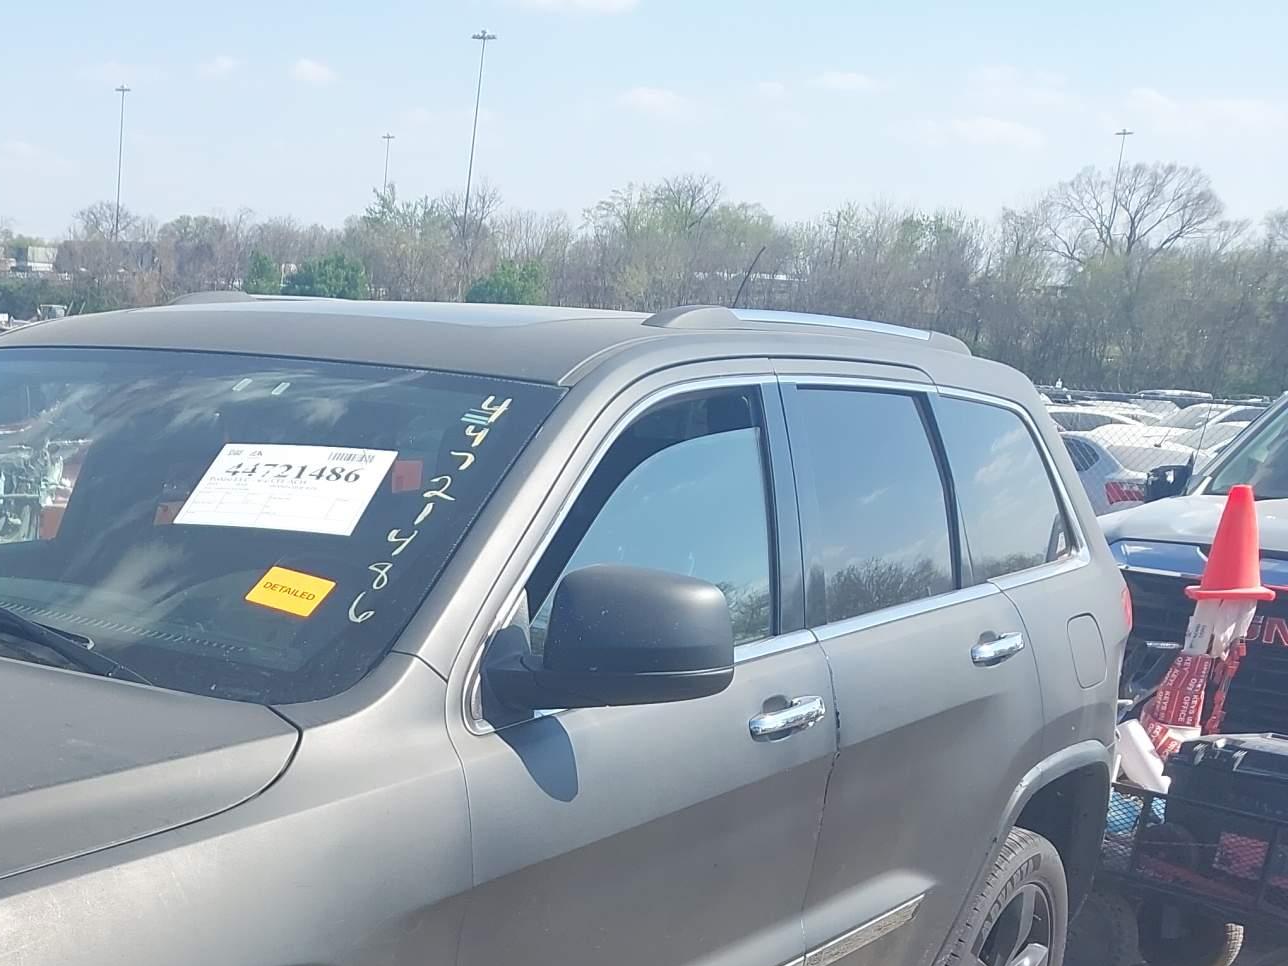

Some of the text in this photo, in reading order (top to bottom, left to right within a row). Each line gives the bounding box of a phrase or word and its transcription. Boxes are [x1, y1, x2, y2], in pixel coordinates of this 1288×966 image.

[225, 462, 364, 484] 44721486
[263, 581, 316, 601] DETAILED
[1178, 696, 1191, 723] OFFICE
